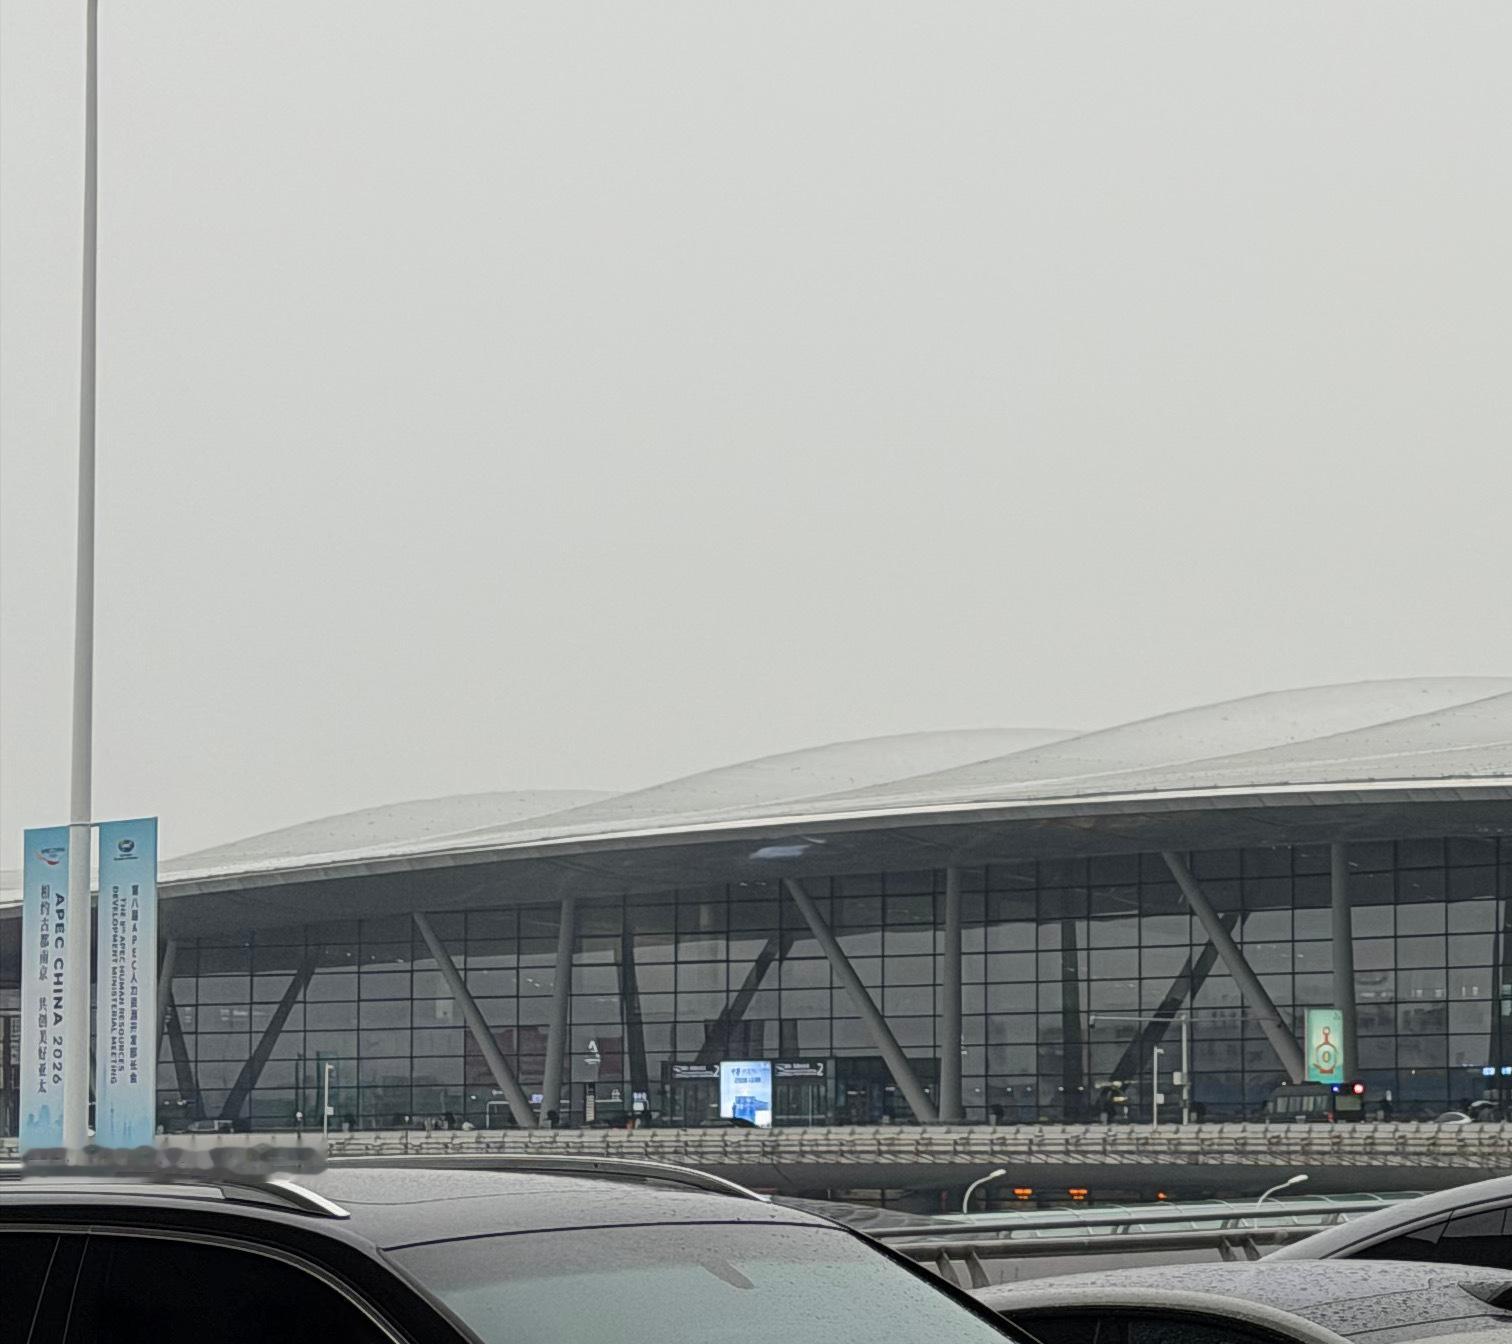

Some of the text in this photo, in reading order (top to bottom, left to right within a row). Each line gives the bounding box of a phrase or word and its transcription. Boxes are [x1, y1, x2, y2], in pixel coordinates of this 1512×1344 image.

[52, 893, 65, 1084] APEC CHINA 2026
